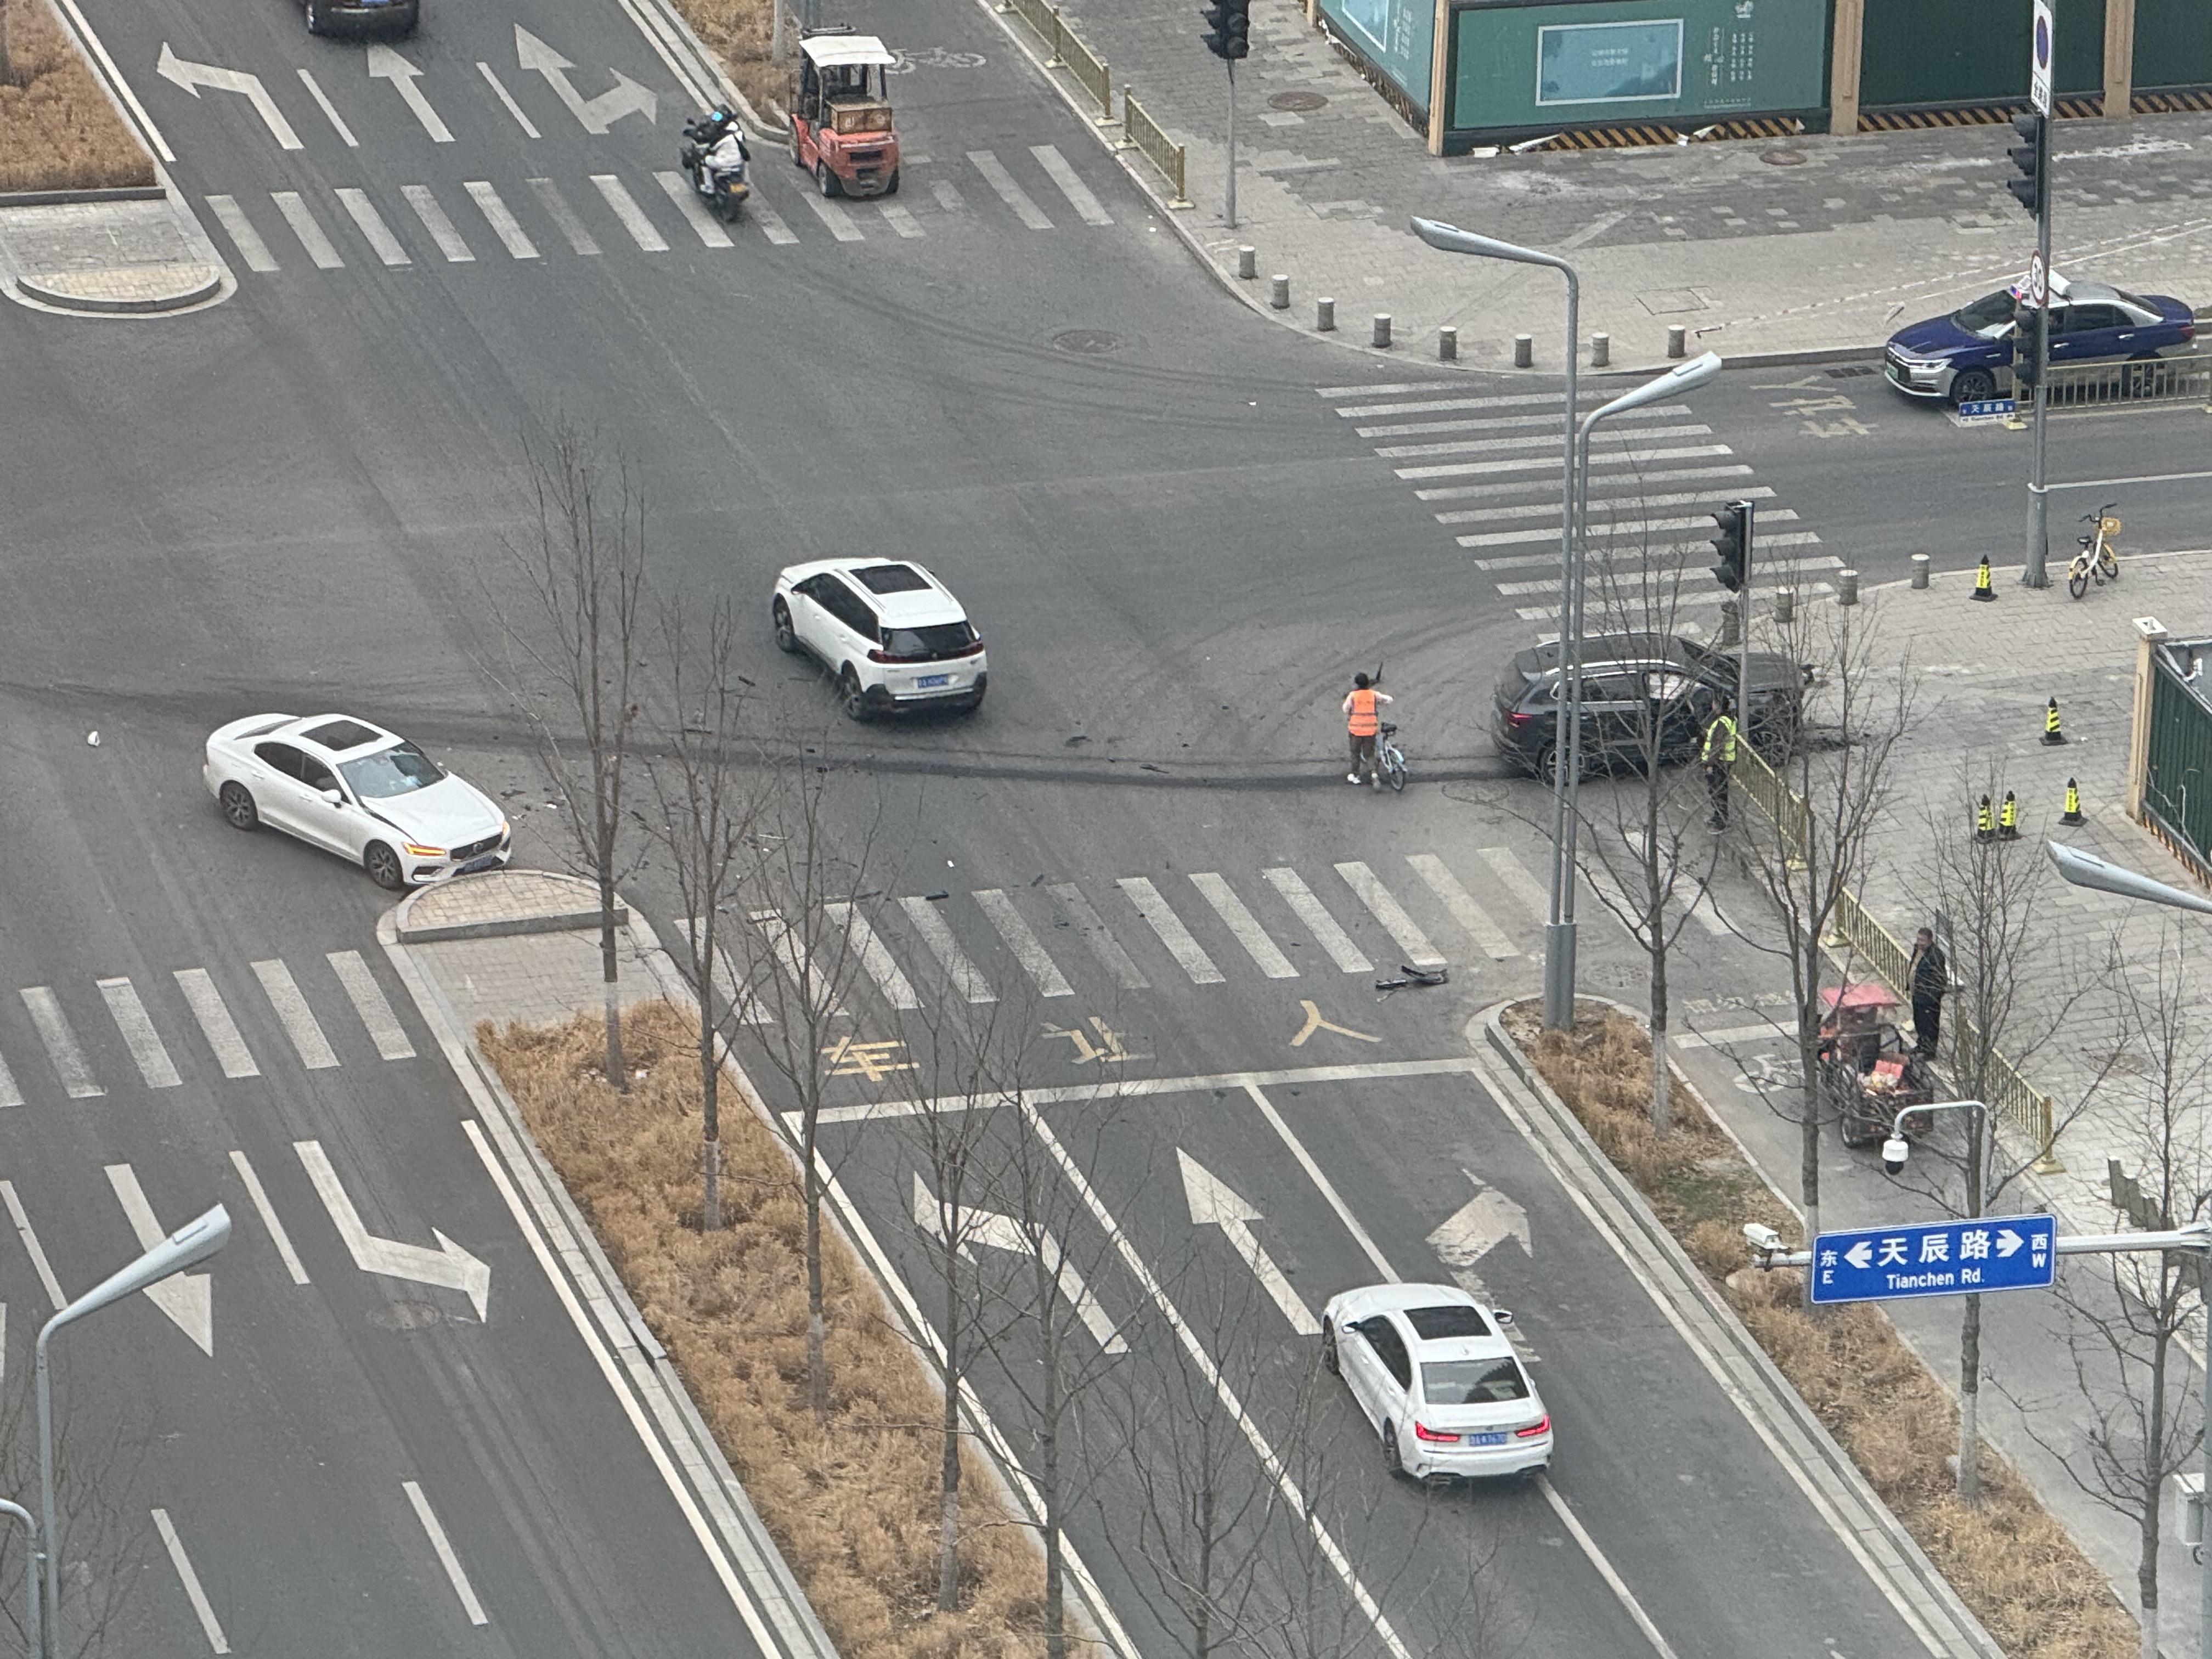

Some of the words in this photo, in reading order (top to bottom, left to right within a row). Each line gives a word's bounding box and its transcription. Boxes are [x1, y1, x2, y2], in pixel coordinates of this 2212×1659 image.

[1877, 1229, 1991, 1267] 天辰路
[2031, 1233, 2049, 1250] 西
[1820, 1249, 1838, 1267] 东
[2032, 1253, 2046, 1268] W
[1822, 1270, 1834, 1285] E
[1887, 1271, 1954, 1290] Tianchen
[1961, 1267, 1984, 1285] Rd.
